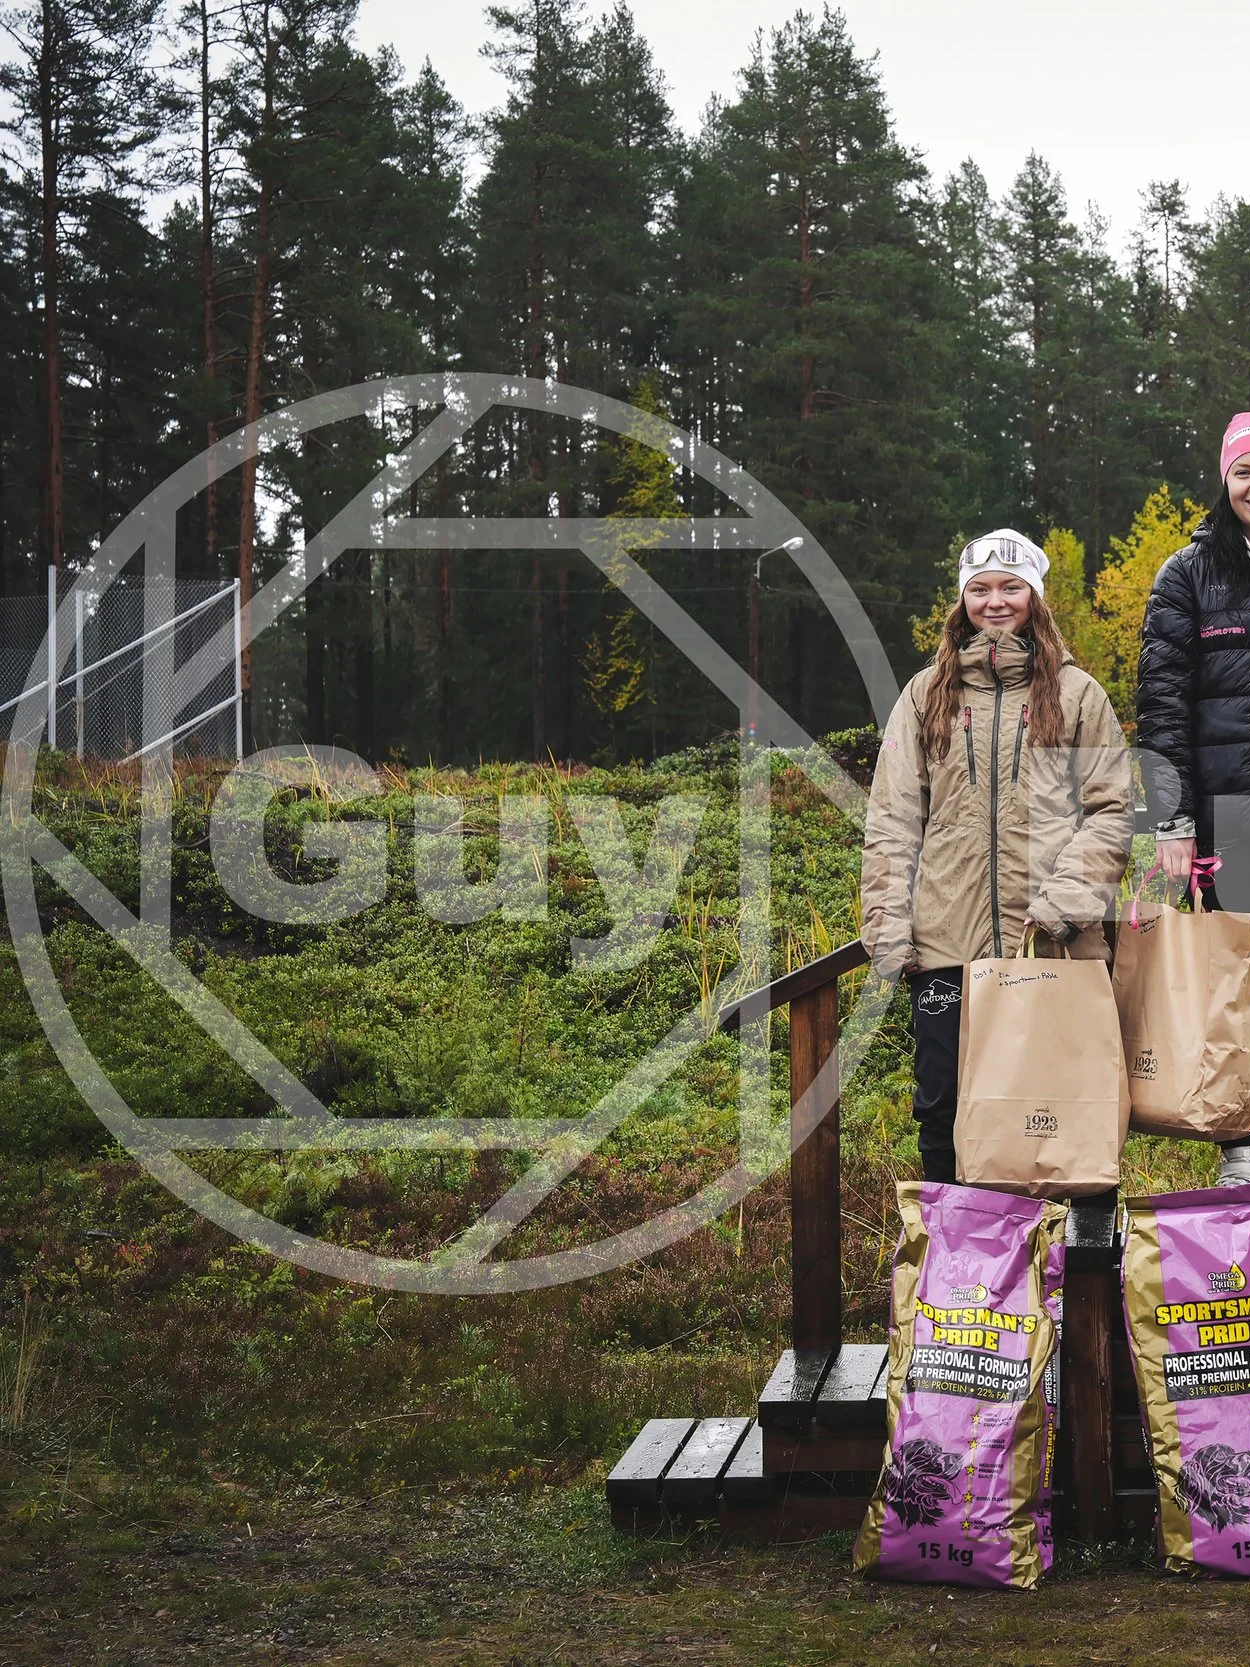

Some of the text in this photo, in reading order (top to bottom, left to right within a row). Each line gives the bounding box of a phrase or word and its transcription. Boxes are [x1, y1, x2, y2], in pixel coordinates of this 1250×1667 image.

[1025, 1114, 1059, 1132] 1923
[1208, 1272, 1240, 1280] OMEGA
[1212, 1280, 1238, 1289] PRIDE
[915, 1297, 1037, 1334] PORTSMAN'S
[933, 1325, 999, 1352] PRIDE
[912, 1349, 975, 1371] FESSIONAL
[978, 1357, 1028, 1378] FORMULA
[1165, 1350, 1248, 1373] PROFESSIONAL
[926, 1368, 975, 1384] PREMIUM
[977, 1375, 999, 1388] DOG
[1001, 1379, 1027, 1391] FOOD
[1167, 1374, 1199, 1387] SUPER
[1201, 1369, 1249, 1384] PREMIUM
[911, 1380, 1010, 1400] 31% PROTEIN 22% FAT
[1189, 1386, 1207, 1396] 31%
[1209, 1382, 1245, 1394] PROTEIN
[918, 1542, 973, 1567] 15 kg
